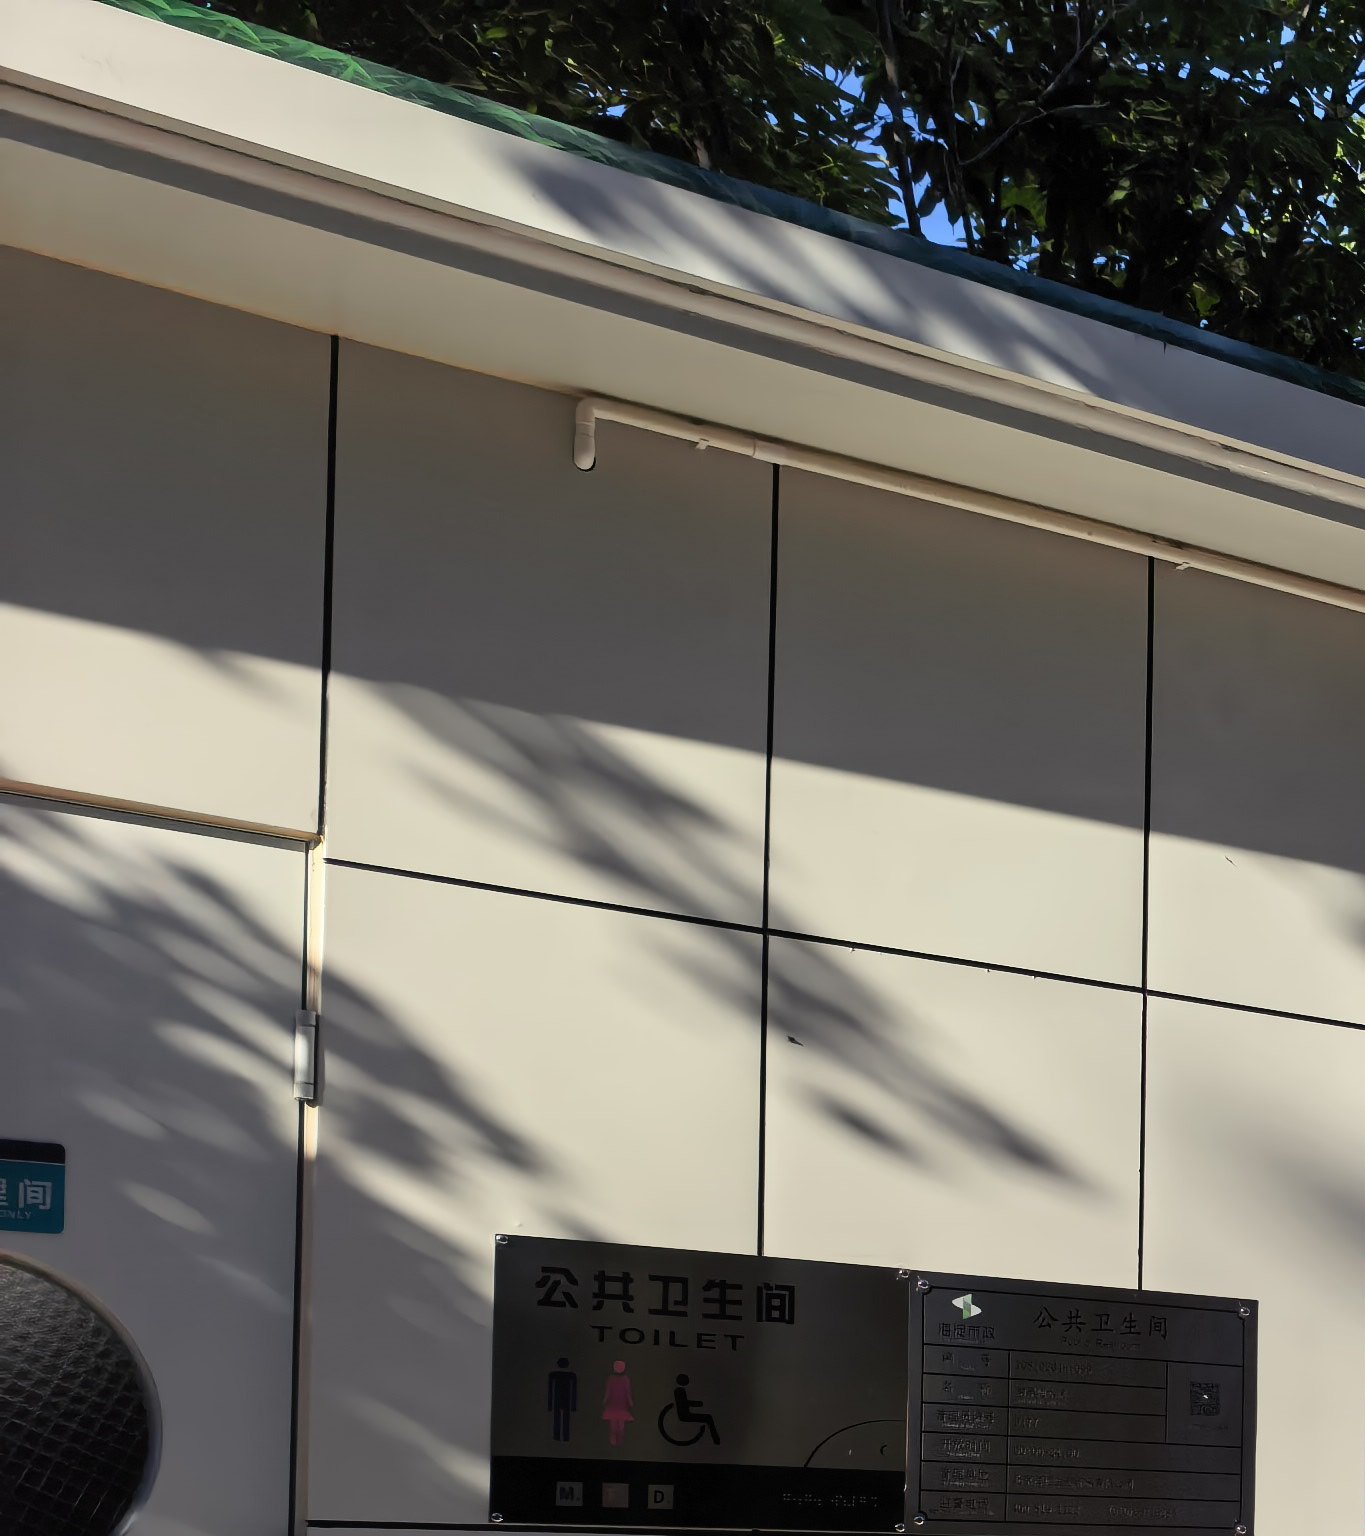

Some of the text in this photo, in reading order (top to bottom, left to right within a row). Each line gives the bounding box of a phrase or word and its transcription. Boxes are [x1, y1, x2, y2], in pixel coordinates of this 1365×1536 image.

[0, 1178, 52, 1210] 间
[534, 1265, 796, 1325] 公共卫生间
[589, 1324, 745, 1352] TOILET
[1032, 1305, 1168, 1340] 公共卫生间
[654, 1490, 665, 1504] D
